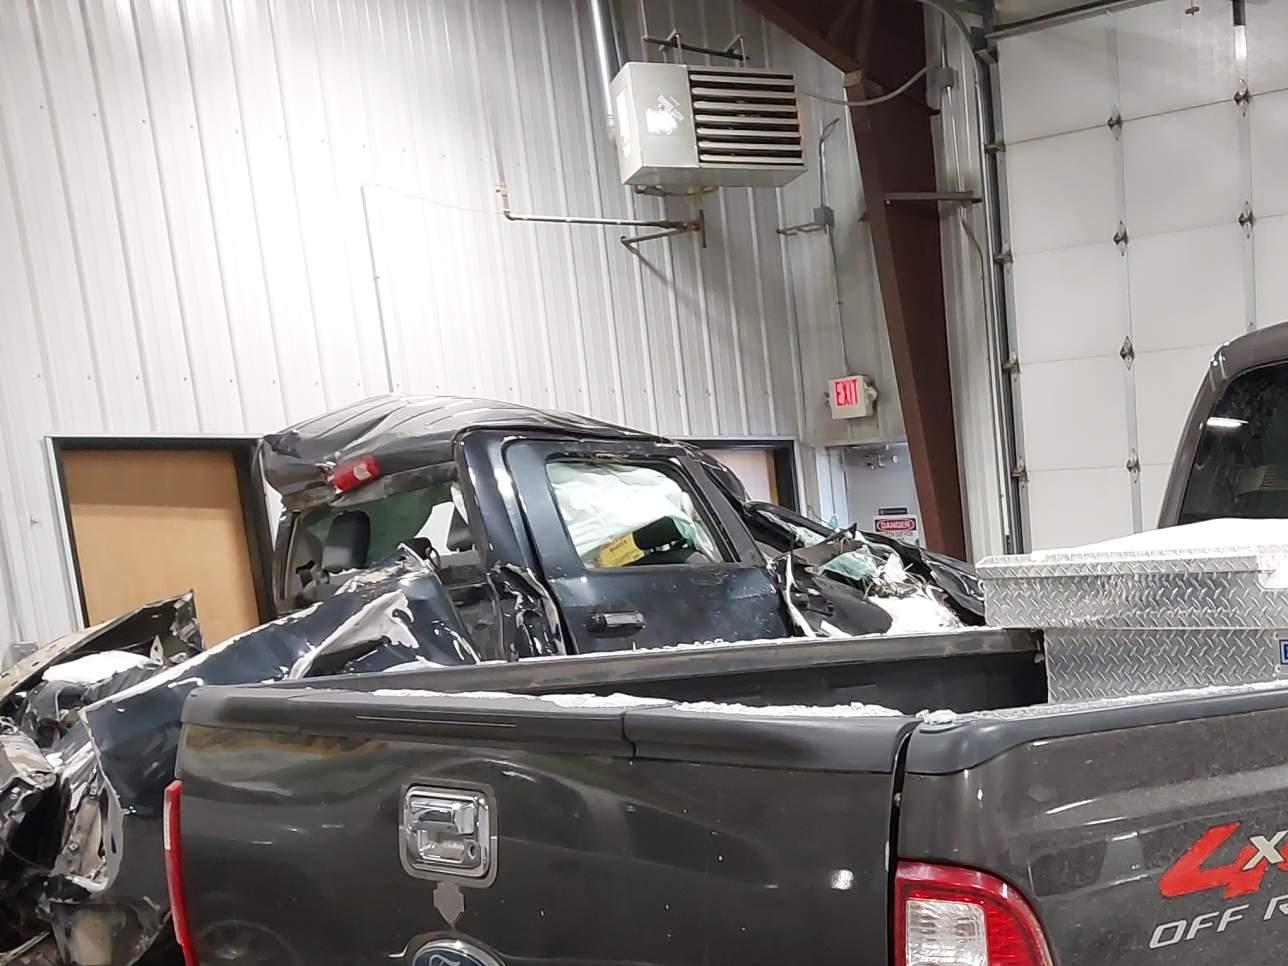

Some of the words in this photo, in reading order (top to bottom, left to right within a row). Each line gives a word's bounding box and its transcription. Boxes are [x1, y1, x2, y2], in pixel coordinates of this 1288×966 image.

[835, 379, 858, 406] EXIT
[880, 521, 911, 529] DANGER
[1148, 903, 1249, 950] OFF
